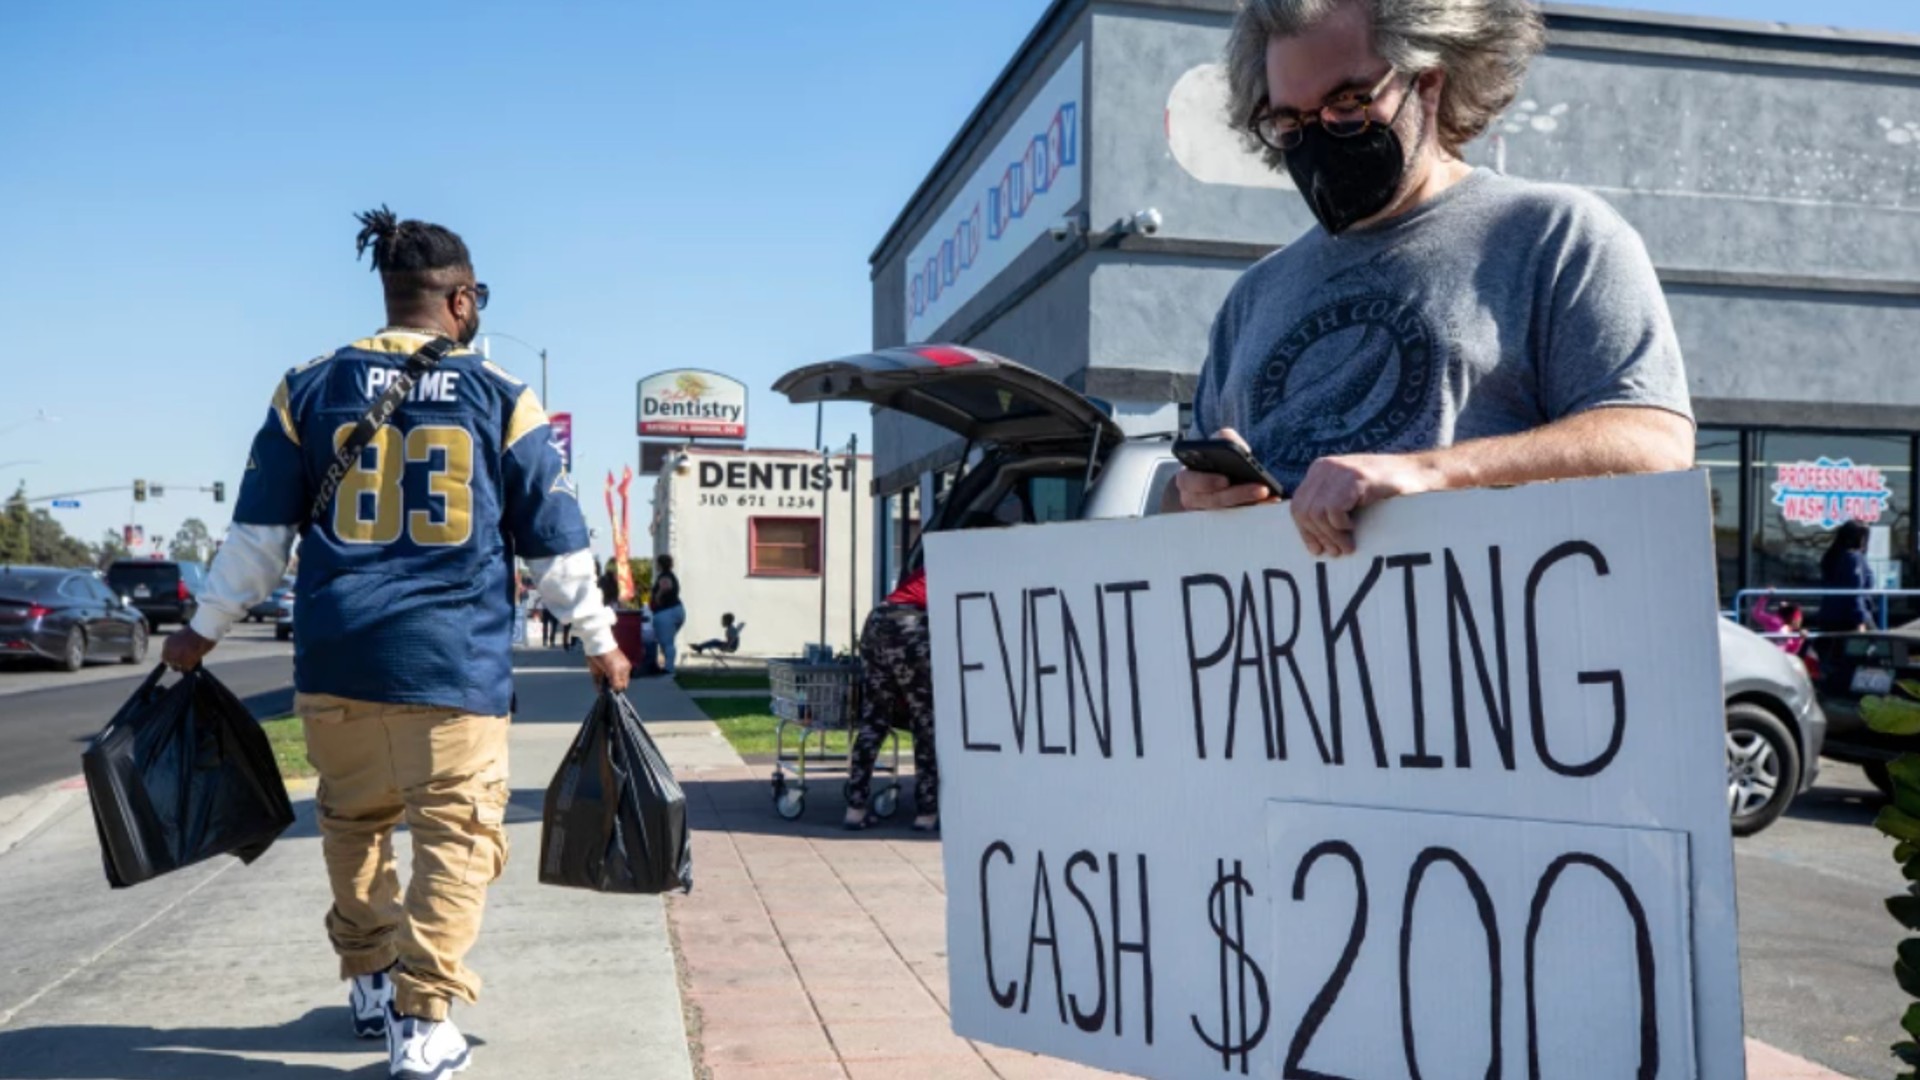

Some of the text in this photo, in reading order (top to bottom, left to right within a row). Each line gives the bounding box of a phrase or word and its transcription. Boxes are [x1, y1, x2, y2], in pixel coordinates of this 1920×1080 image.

[987, 102, 1076, 241] LAUNDRY
[1260, 307, 1341, 409] NORTH
[1352, 299, 1429, 345] COAST
[643, 397, 742, 422] Dentistry
[332, 421, 474, 547] 83
[698, 493, 815, 508] 310 671 1234
[699, 461, 854, 492] DENTIST
[1777, 465, 1882, 491] PROFESSIONAL
[1783, 496, 1824, 522] WASH
[1845, 497, 1881, 522] FOLD
[955, 540, 1627, 778] EVENT PARKING
[979, 838, 1660, 1080] CASH $200
